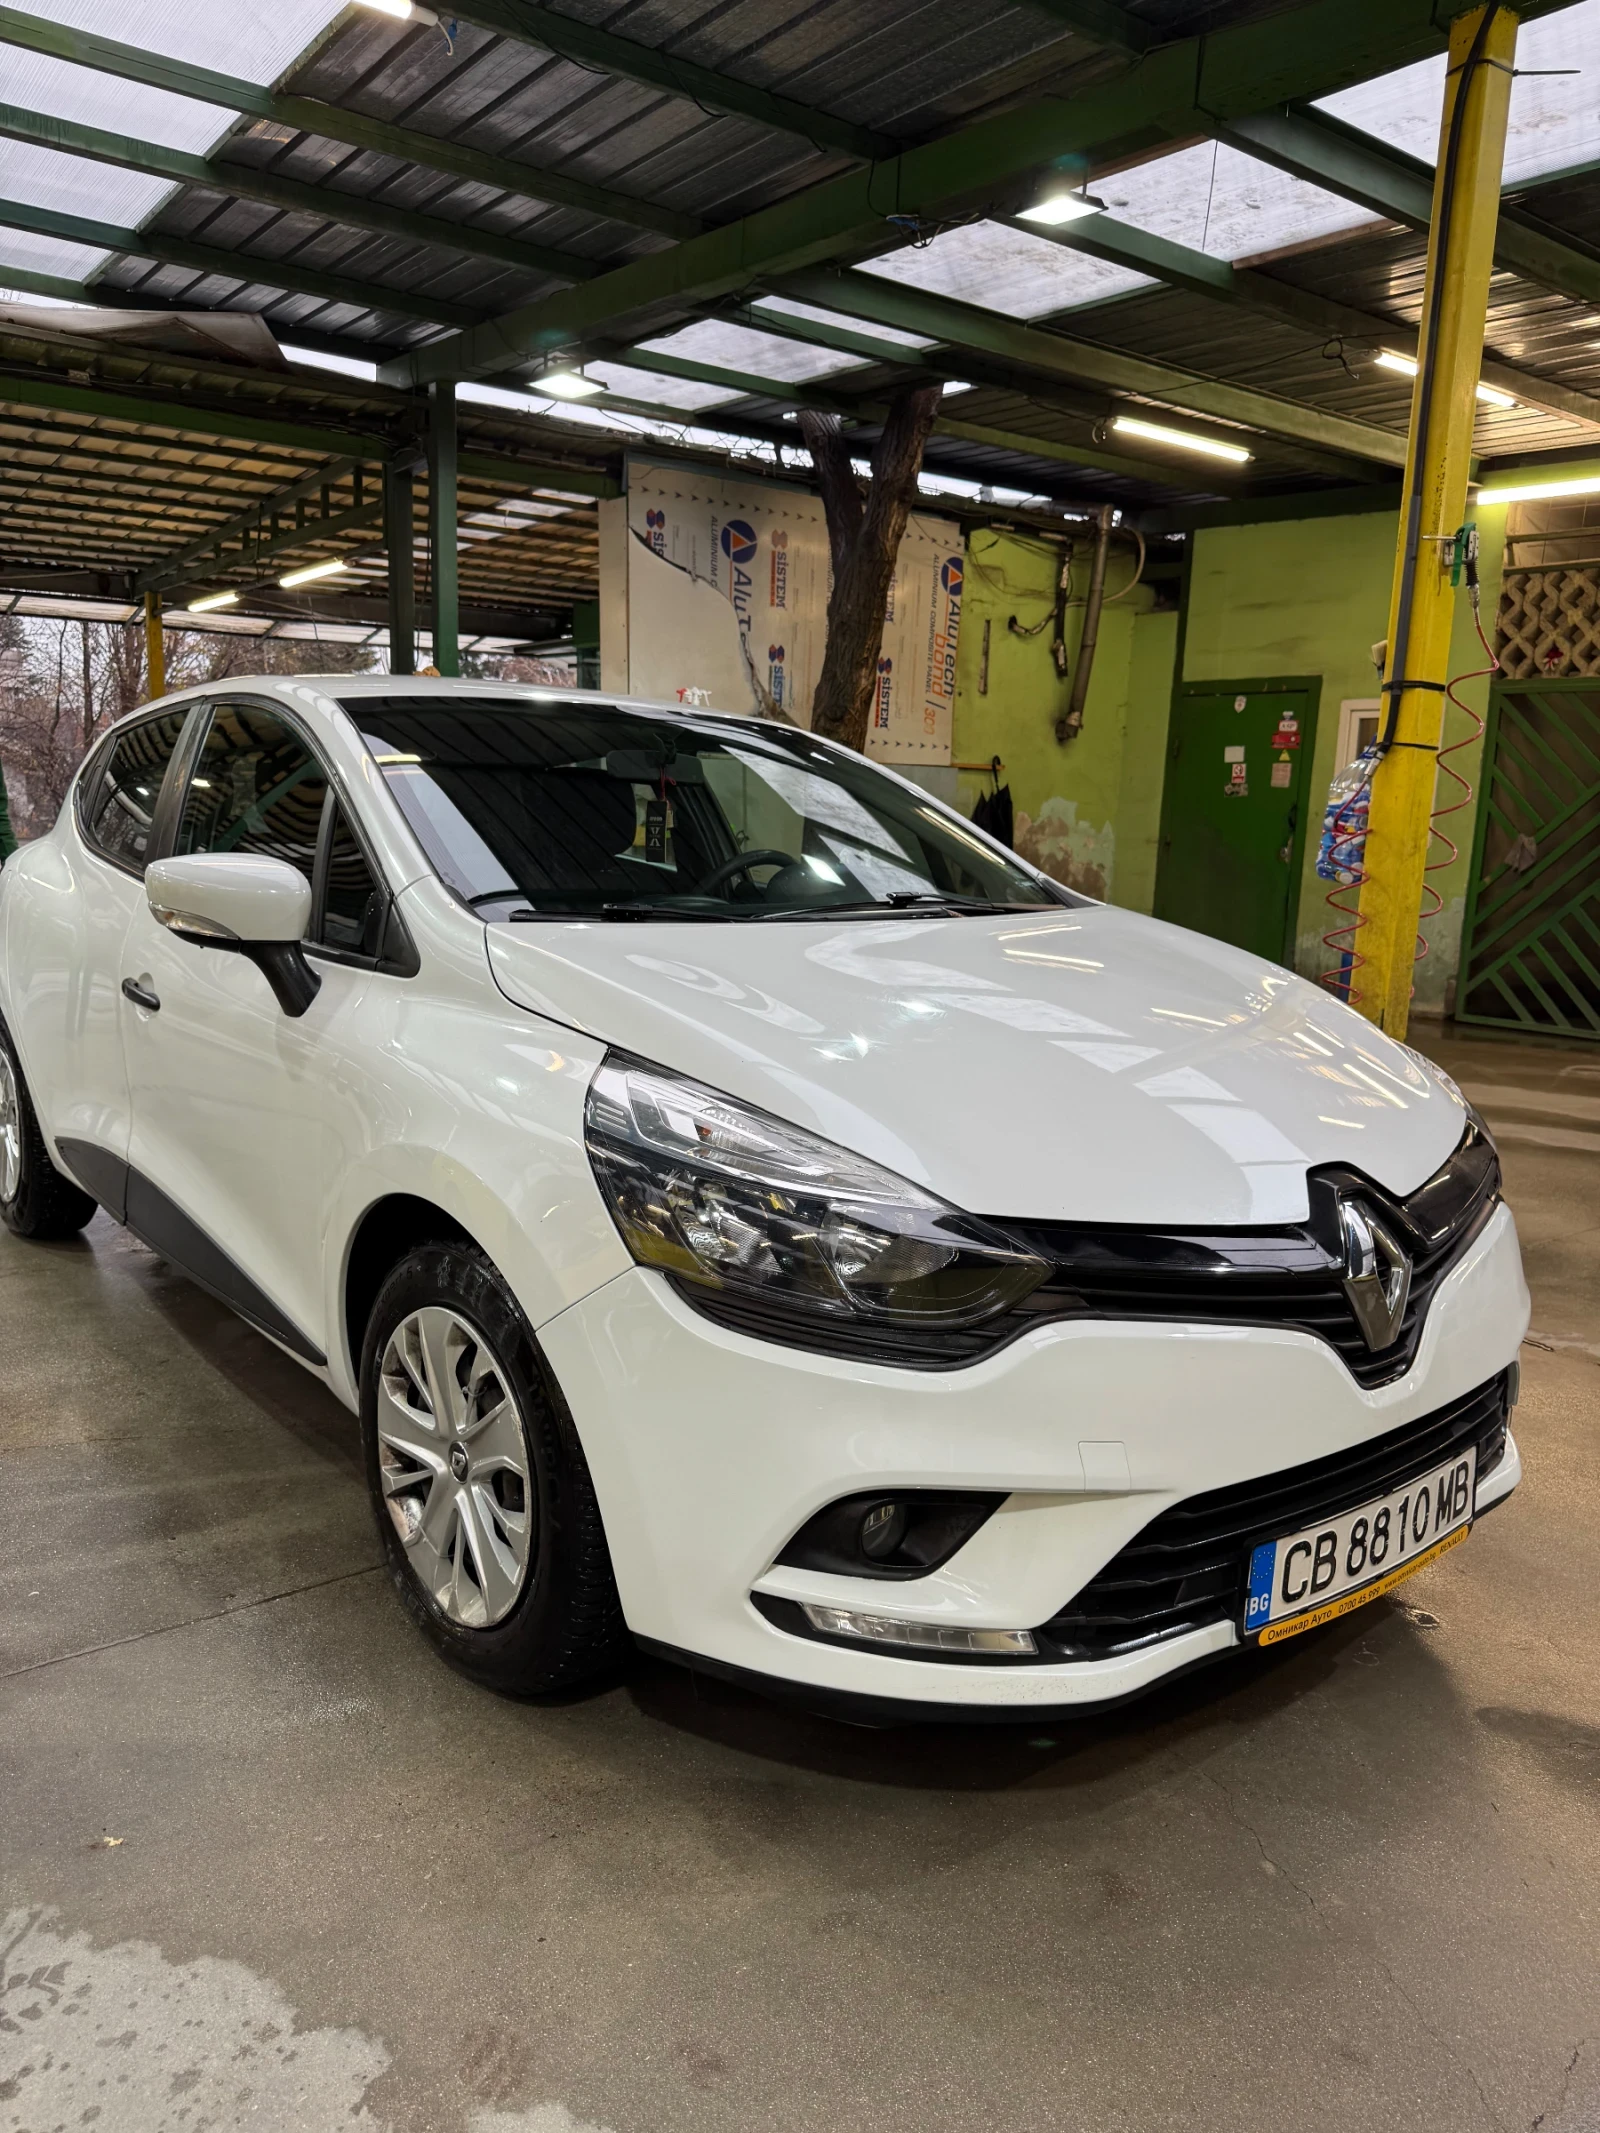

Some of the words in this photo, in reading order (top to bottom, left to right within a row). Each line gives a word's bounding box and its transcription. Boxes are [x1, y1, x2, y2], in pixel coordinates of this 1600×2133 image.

[710, 515, 719, 577] ALUMINIUM
[929, 553, 940, 609] ALUMINIUM
[926, 610, 937, 663] COMPOSITE
[931, 633, 951, 699] bond
[925, 664, 934, 693] PANEL
[1281, 1529, 1338, 1604] CB
[1346, 1485, 1431, 1577] 8810
[1435, 1460, 1470, 1533] MB
[1249, 1593, 1269, 1616] BG
[1267, 1618, 1309, 1641] Омникар
[1310, 1608, 1332, 1627] Ауто
[1337, 1597, 1358, 1614] 0700
[1357, 1593, 1367, 1607] 45
[1368, 1586, 1381, 1602] 999
[1439, 1531, 1465, 1554] RENAULT
